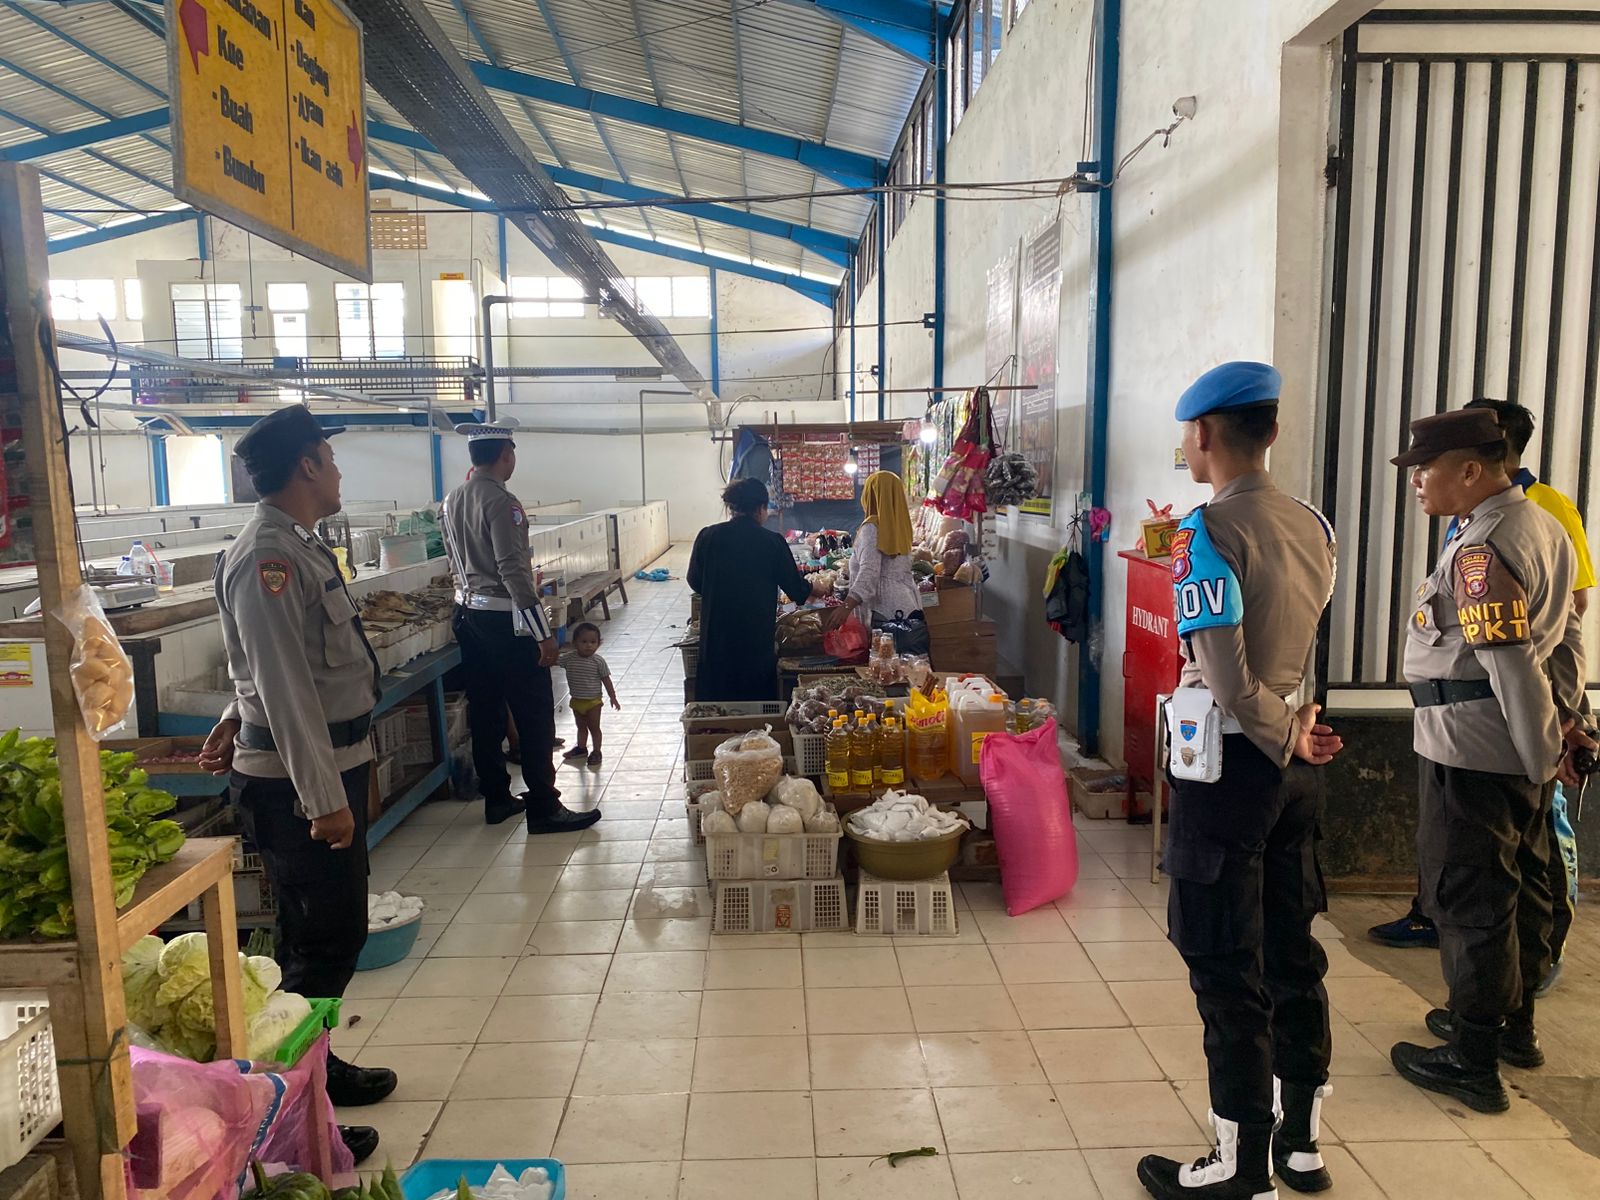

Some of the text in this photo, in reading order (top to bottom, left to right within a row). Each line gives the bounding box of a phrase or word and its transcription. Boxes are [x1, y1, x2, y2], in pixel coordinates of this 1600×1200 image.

[217, 24, 243, 71] Kue
[296, 39, 330, 98] Daging
[220, 85, 253, 134] Buah
[298, 91, 324, 128] Ayam
[223, 144, 265, 195] Bumbu
[1132, 605, 1169, 639] HYDRANT
